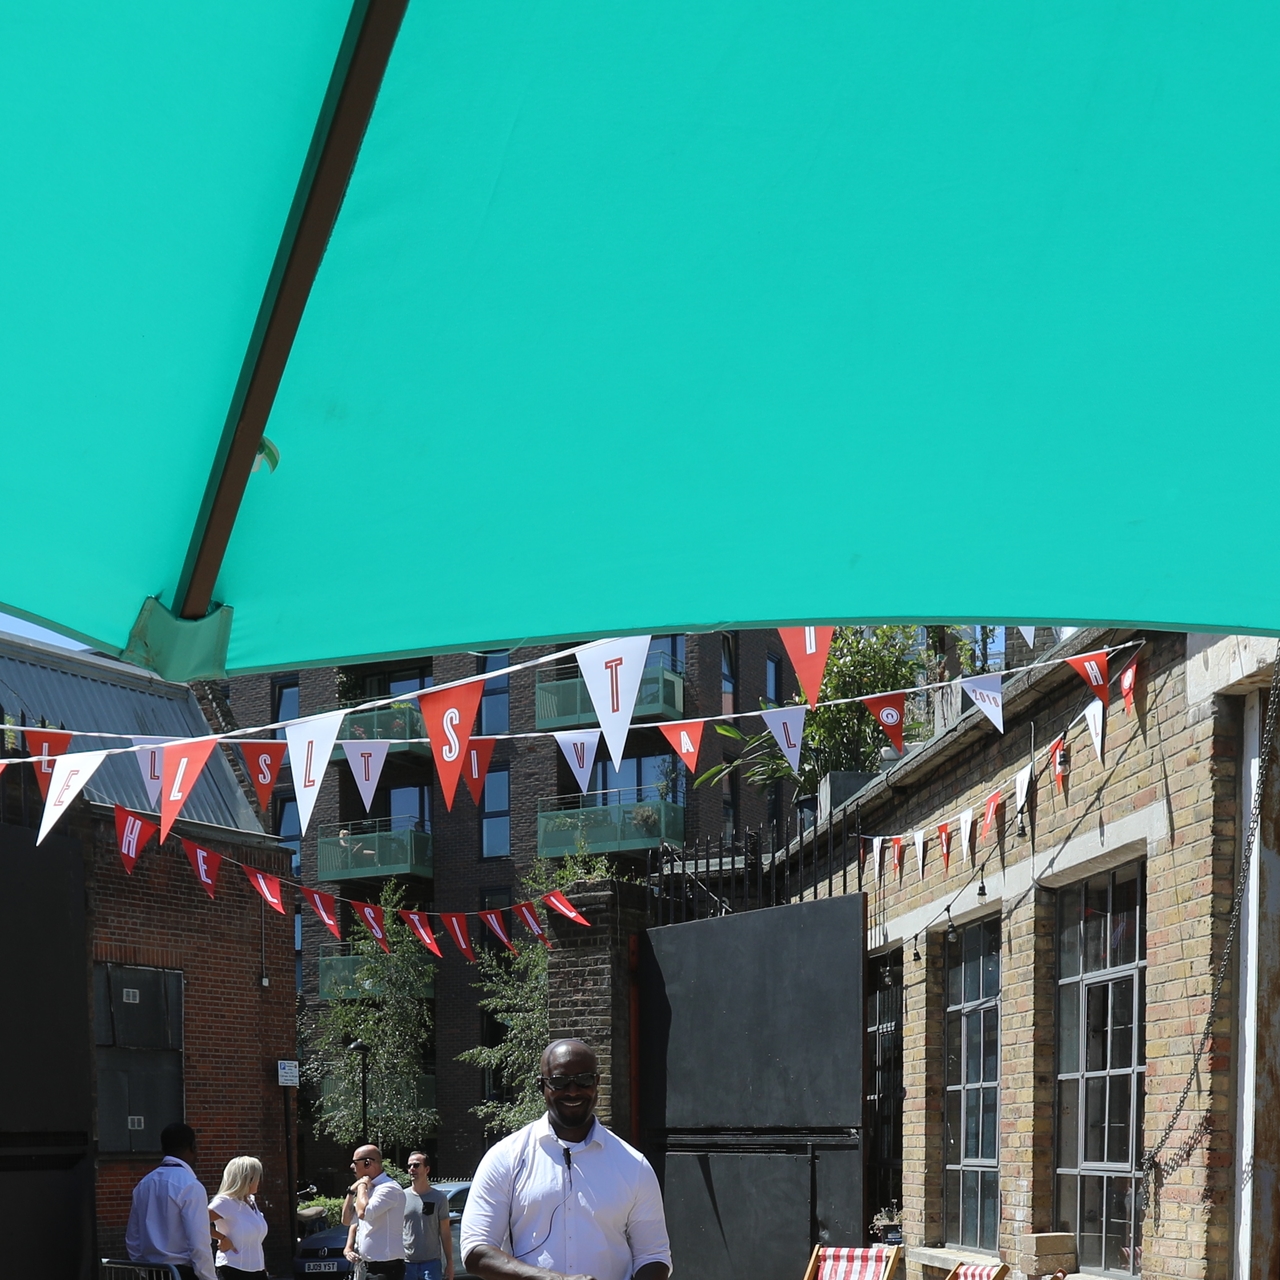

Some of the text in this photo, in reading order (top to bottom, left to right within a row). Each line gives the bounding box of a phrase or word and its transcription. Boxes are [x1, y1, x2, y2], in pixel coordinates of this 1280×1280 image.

[150, 751, 160, 780] L
[258, 753, 271, 784] S
[360, 752, 372, 781] T
[573, 742, 585, 769] V
[680, 730, 695, 753] A
[782, 721, 796, 748] L
[1083, 660, 1104, 686] H
[170, 757, 188, 801] L
[303, 740, 315, 788] L
[442, 707, 460, 763] S
[604, 656, 623, 713] T
[121, 815, 142, 859] H
[196, 848, 213, 885] E
[256, 873, 279, 904] L
[313, 893, 334, 926] L
[363, 907, 383, 939] S
[408, 914, 432, 944] T
[486, 914, 509, 944] V
[521, 907, 543, 936] A
[549, 895, 577, 918] L
[323, 1263, 336, 1271] YST
